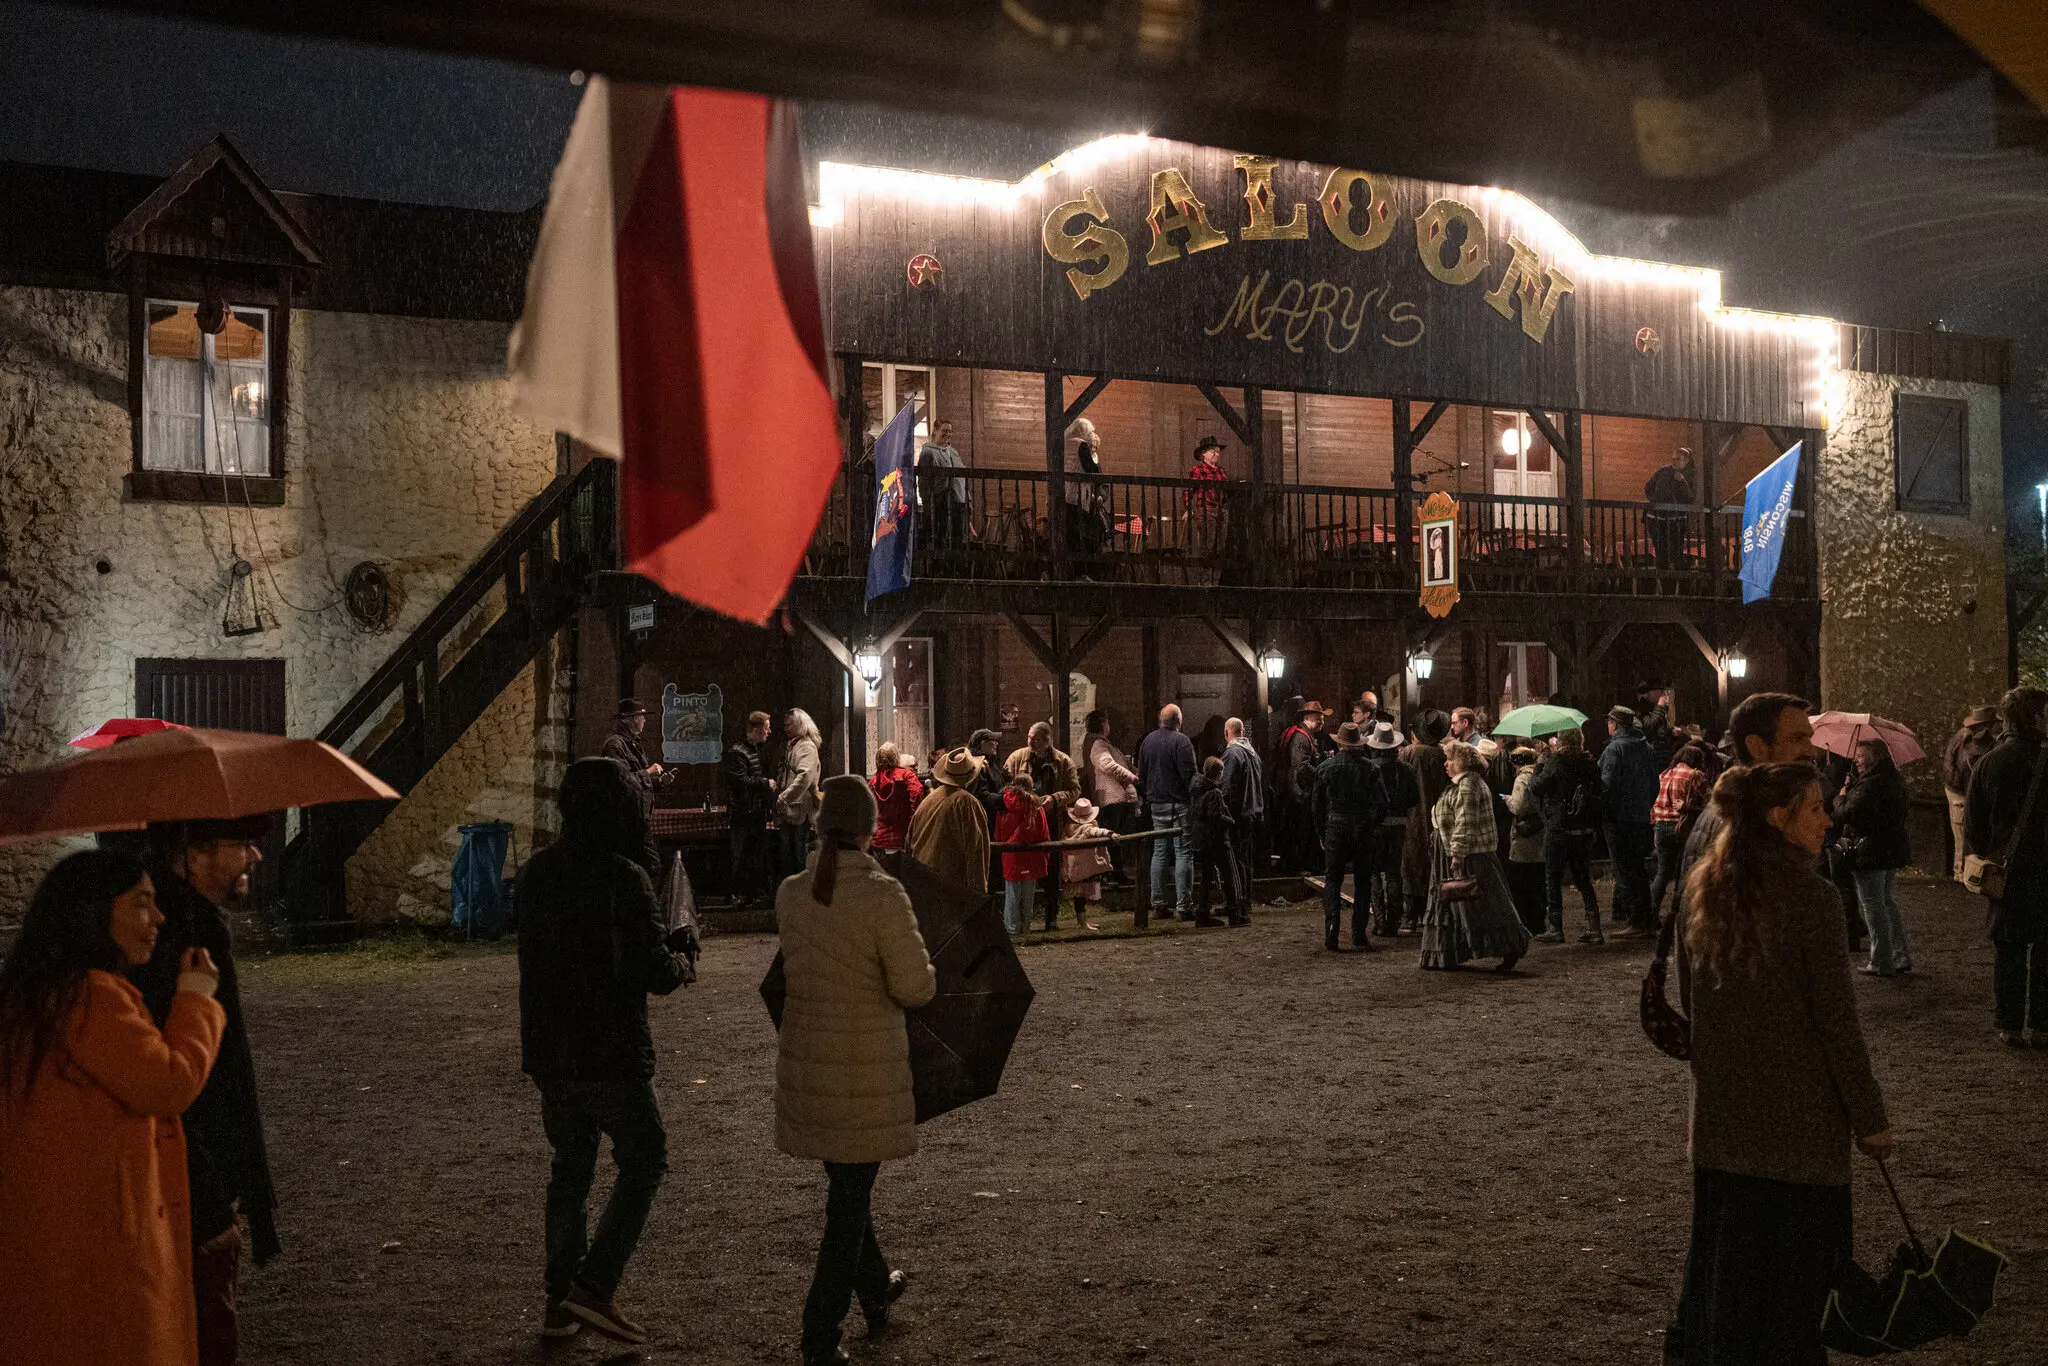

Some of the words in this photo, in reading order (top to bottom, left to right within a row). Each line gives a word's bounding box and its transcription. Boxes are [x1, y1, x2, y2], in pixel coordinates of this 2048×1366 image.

[1044, 154, 1576, 343] SALOON
[1204, 270, 1425, 354] MARY'S
[673, 697, 708, 707] PINTO
